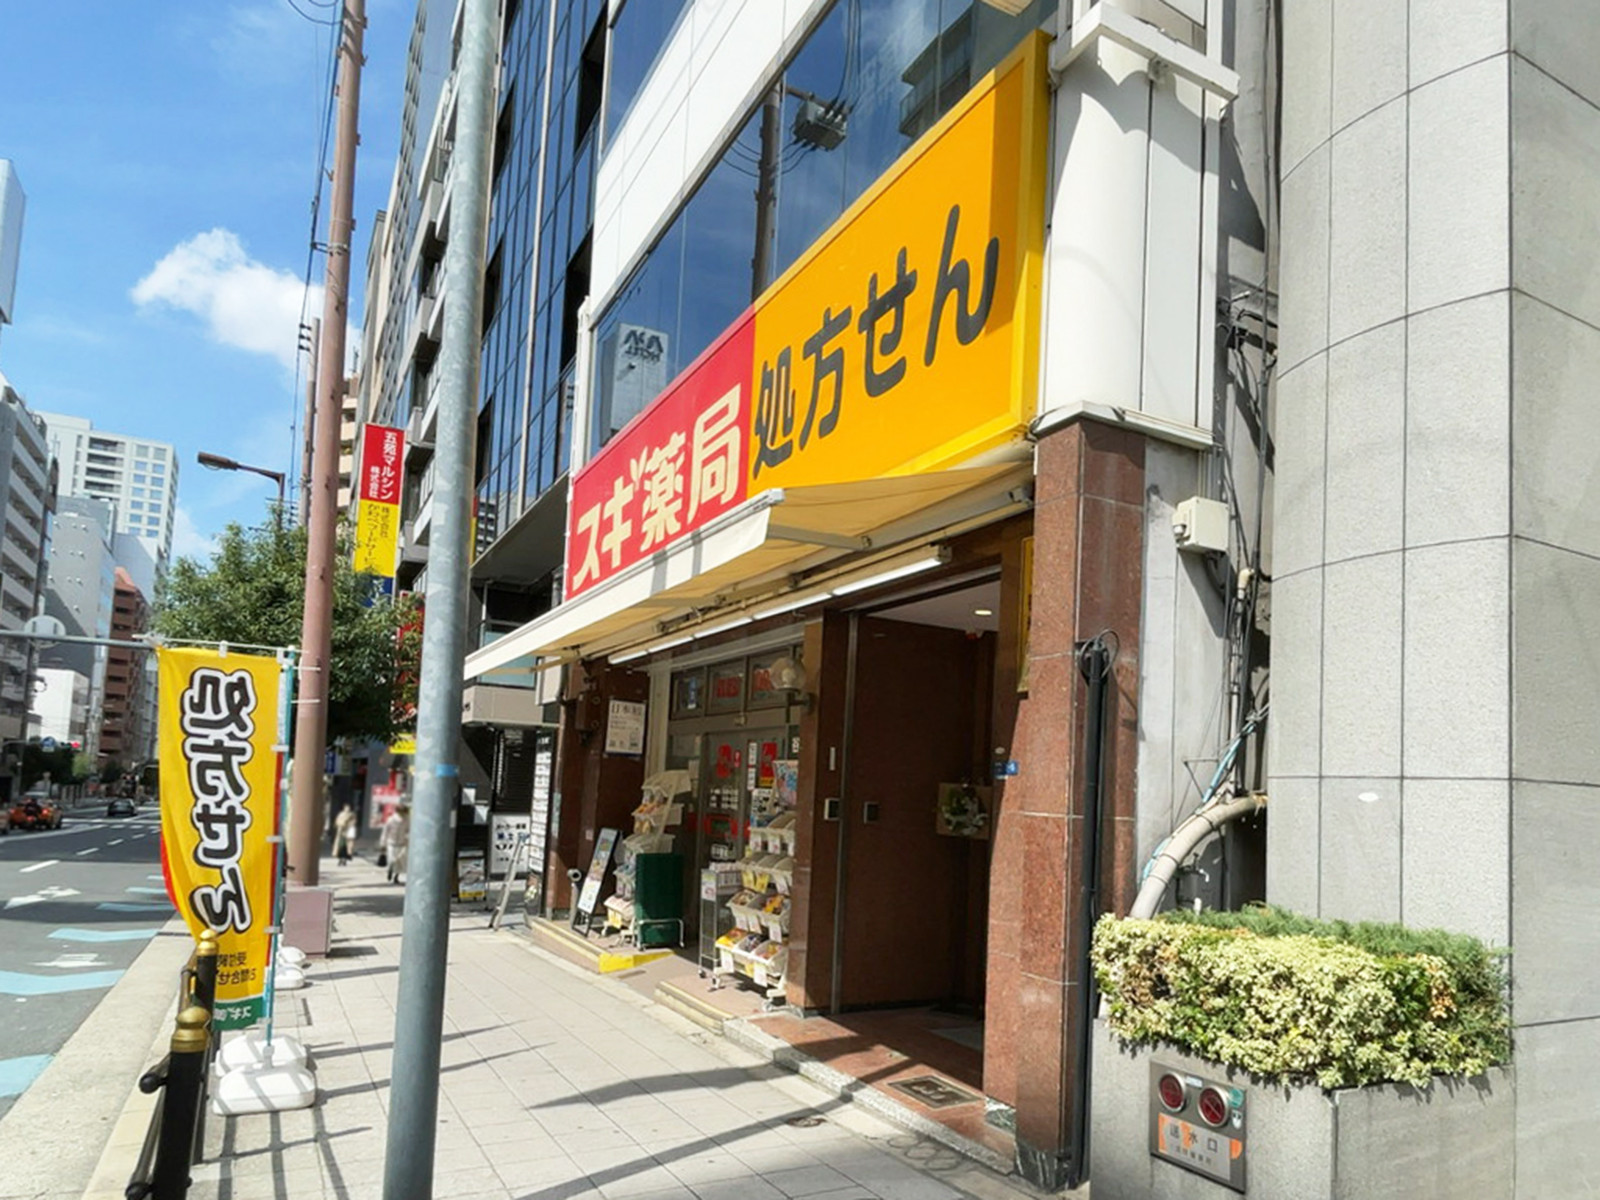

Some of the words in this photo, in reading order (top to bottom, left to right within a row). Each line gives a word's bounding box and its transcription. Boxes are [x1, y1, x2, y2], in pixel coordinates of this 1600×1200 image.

[753, 204, 999, 480] 処方せん
[368, 465, 381, 499] 株式会社
[572, 383, 742, 591] スギ薬局
[1170, 1123, 1218, 1153] 送水口
